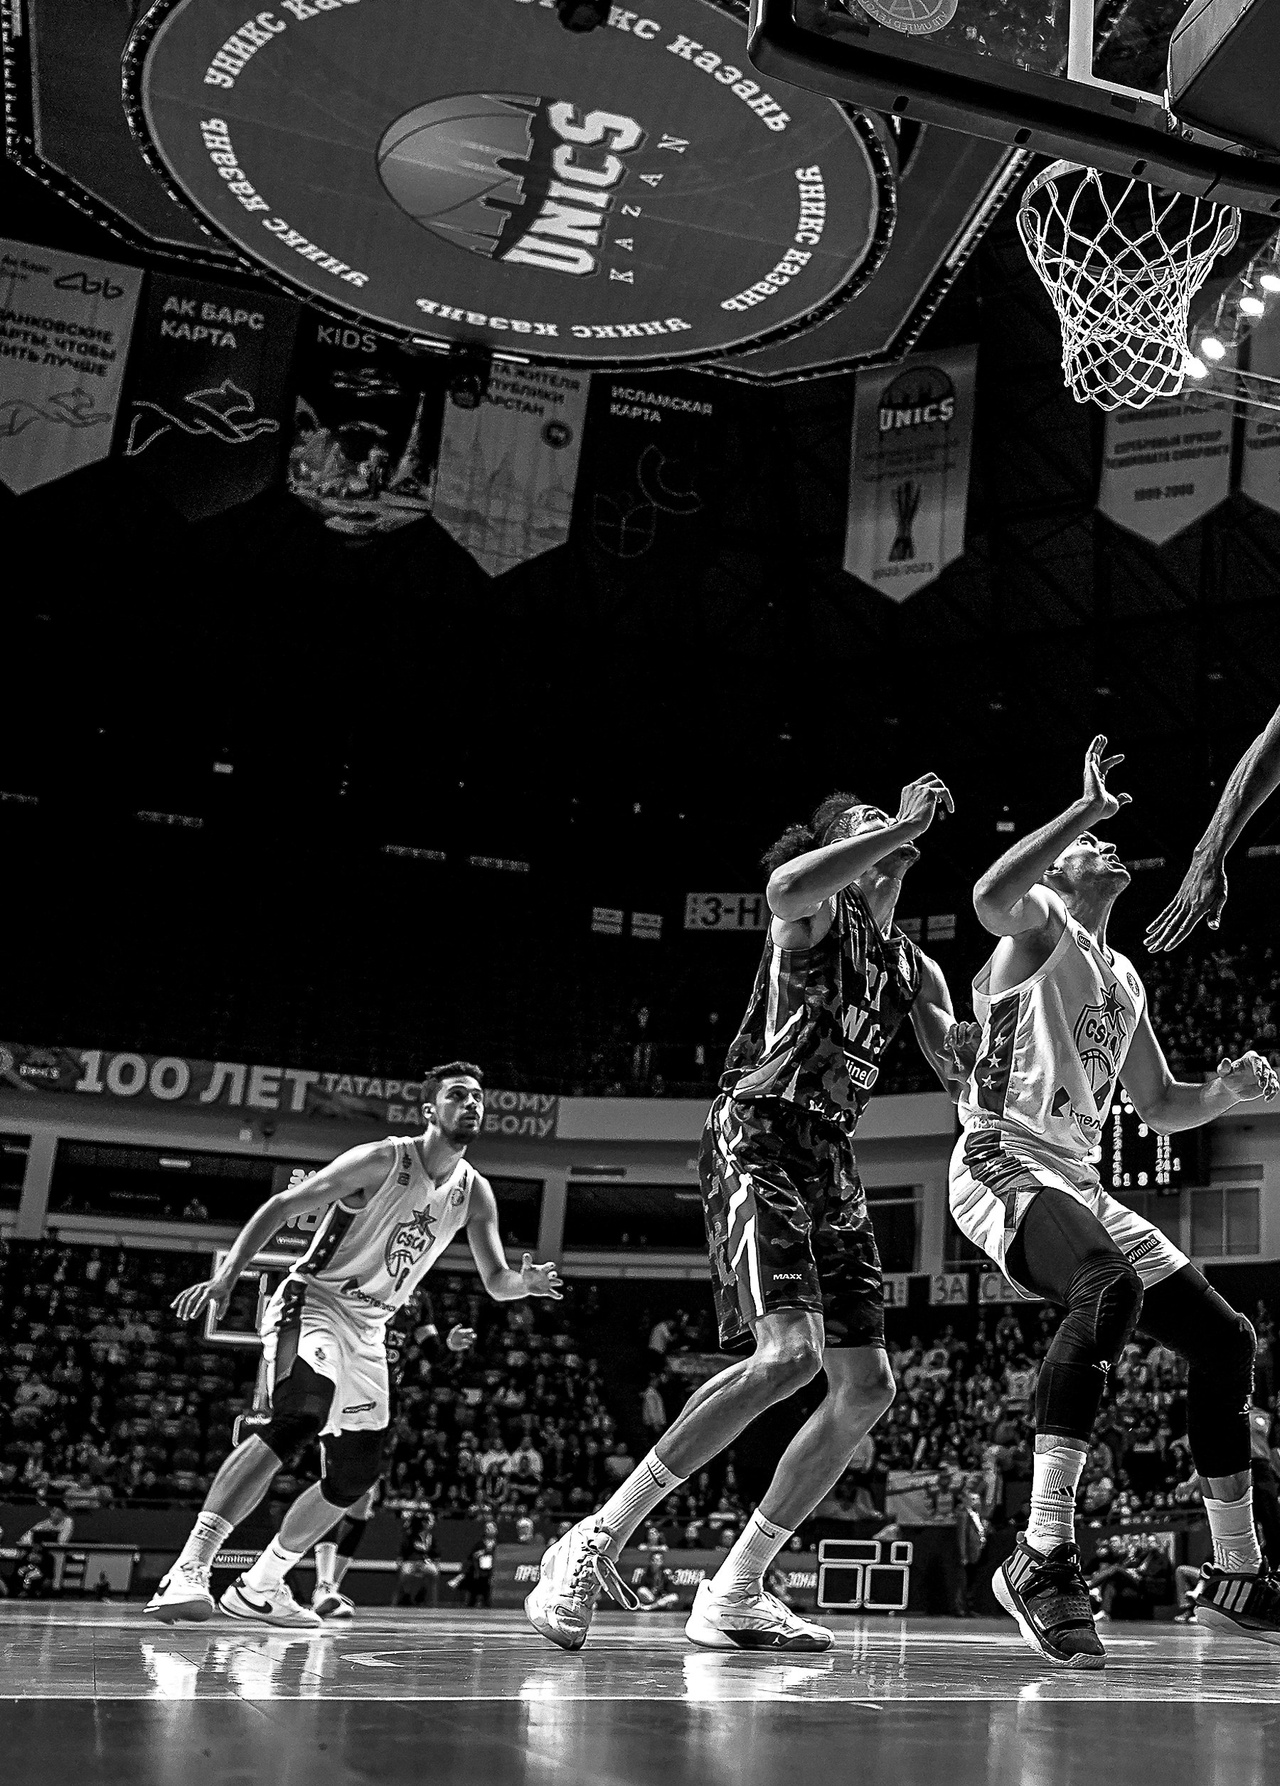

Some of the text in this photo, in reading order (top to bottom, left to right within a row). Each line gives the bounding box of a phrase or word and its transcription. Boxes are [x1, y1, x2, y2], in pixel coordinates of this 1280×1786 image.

[501, 101, 643, 276] UNICS
[609, 133, 691, 285] KAZAN
[162, 295, 266, 331] АК БАРС
[0, 325, 117, 362] АРТЫ, ЧТОБЫ
[160, 319, 238, 349] КАРТА
[317, 324, 378, 352] KIDS
[610, 402, 662, 423] КАРТА
[611, 384, 713, 417] ИСЛАМСКАЯ
[879, 396, 955, 431] UNICS
[75, 1049, 320, 1112] 100 ЛЕТ
[845, 1059, 867, 1081] line
[322, 1073, 557, 1113] ТАТАРСКОМУ
[387, 1104, 555, 1139] БАБОЛУ
[1128, 1238, 1158, 1263] Winline
[772, 1272, 802, 1281] MAXX
